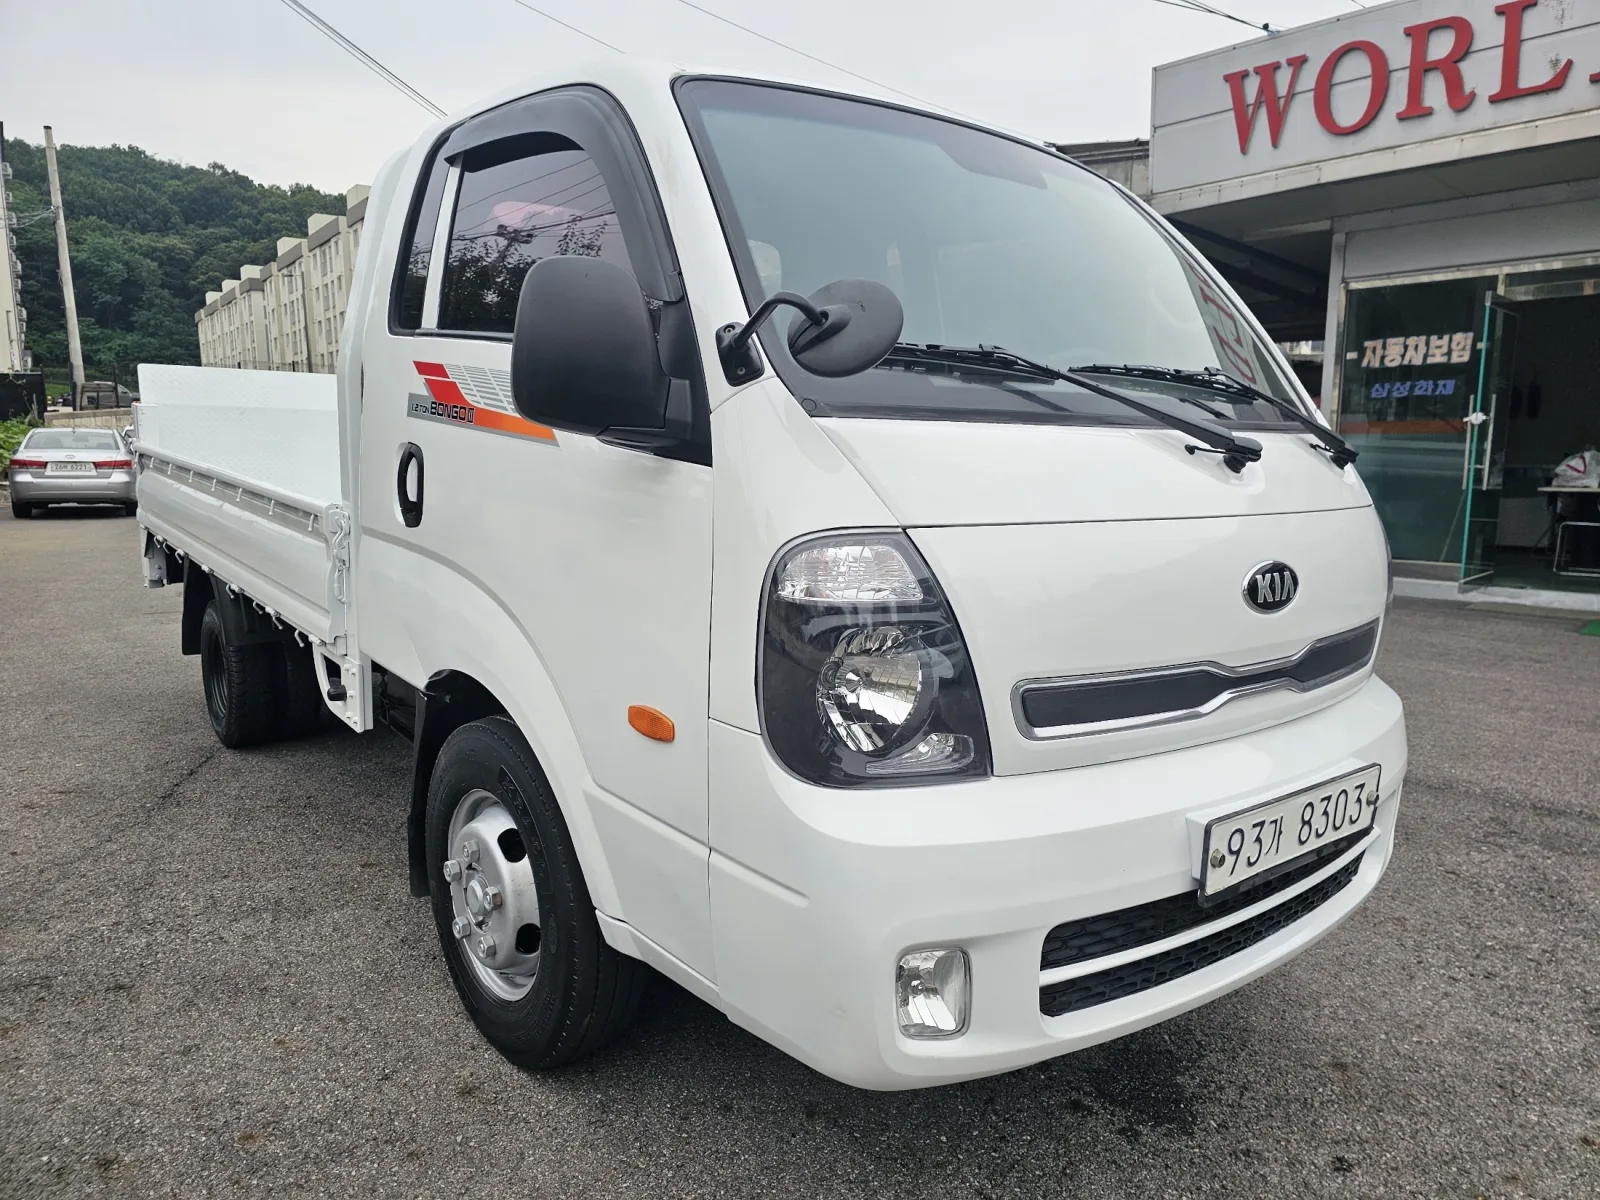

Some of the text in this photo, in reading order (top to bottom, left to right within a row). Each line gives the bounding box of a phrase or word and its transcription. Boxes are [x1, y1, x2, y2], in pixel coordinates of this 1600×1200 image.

[1223, 0, 1600, 154] WORL
[1361, 332, 1474, 368] 자동차보험
[430, 400, 466, 421] BONGO
[1255, 571, 1295, 603] KIA
[1227, 782, 1366, 877] 93가 8303
